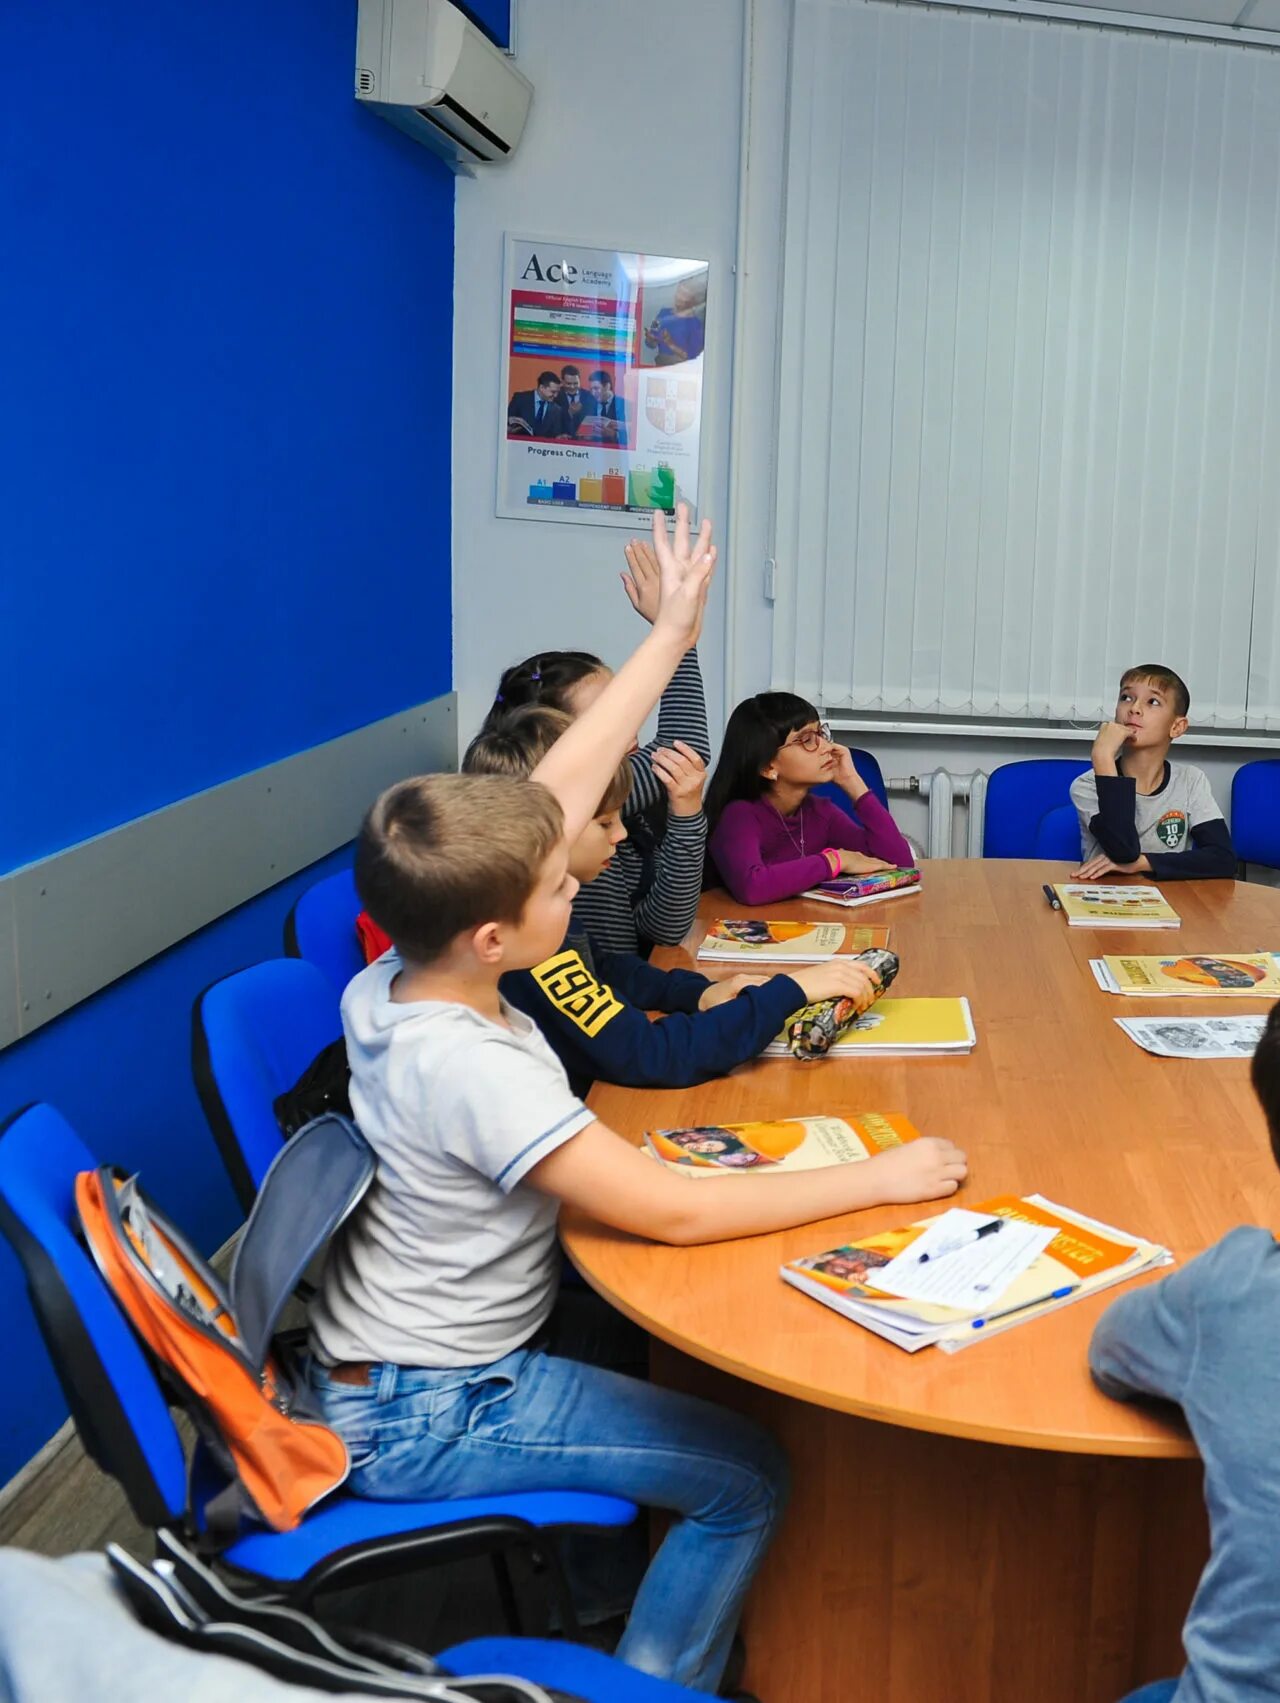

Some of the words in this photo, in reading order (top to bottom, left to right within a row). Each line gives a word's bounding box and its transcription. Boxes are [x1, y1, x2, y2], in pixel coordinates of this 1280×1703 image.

[520, 253, 578, 284] Ace
[582, 269, 612, 279] Language
[581, 278, 611, 286] Academy
[527, 446, 564, 457] Progress
[565, 450, 589, 459] Chart
[586, 471, 597, 479] B1
[608, 467, 619, 476] B2
[559, 475, 571, 483] A2
[1166, 824, 1178, 834] 10
